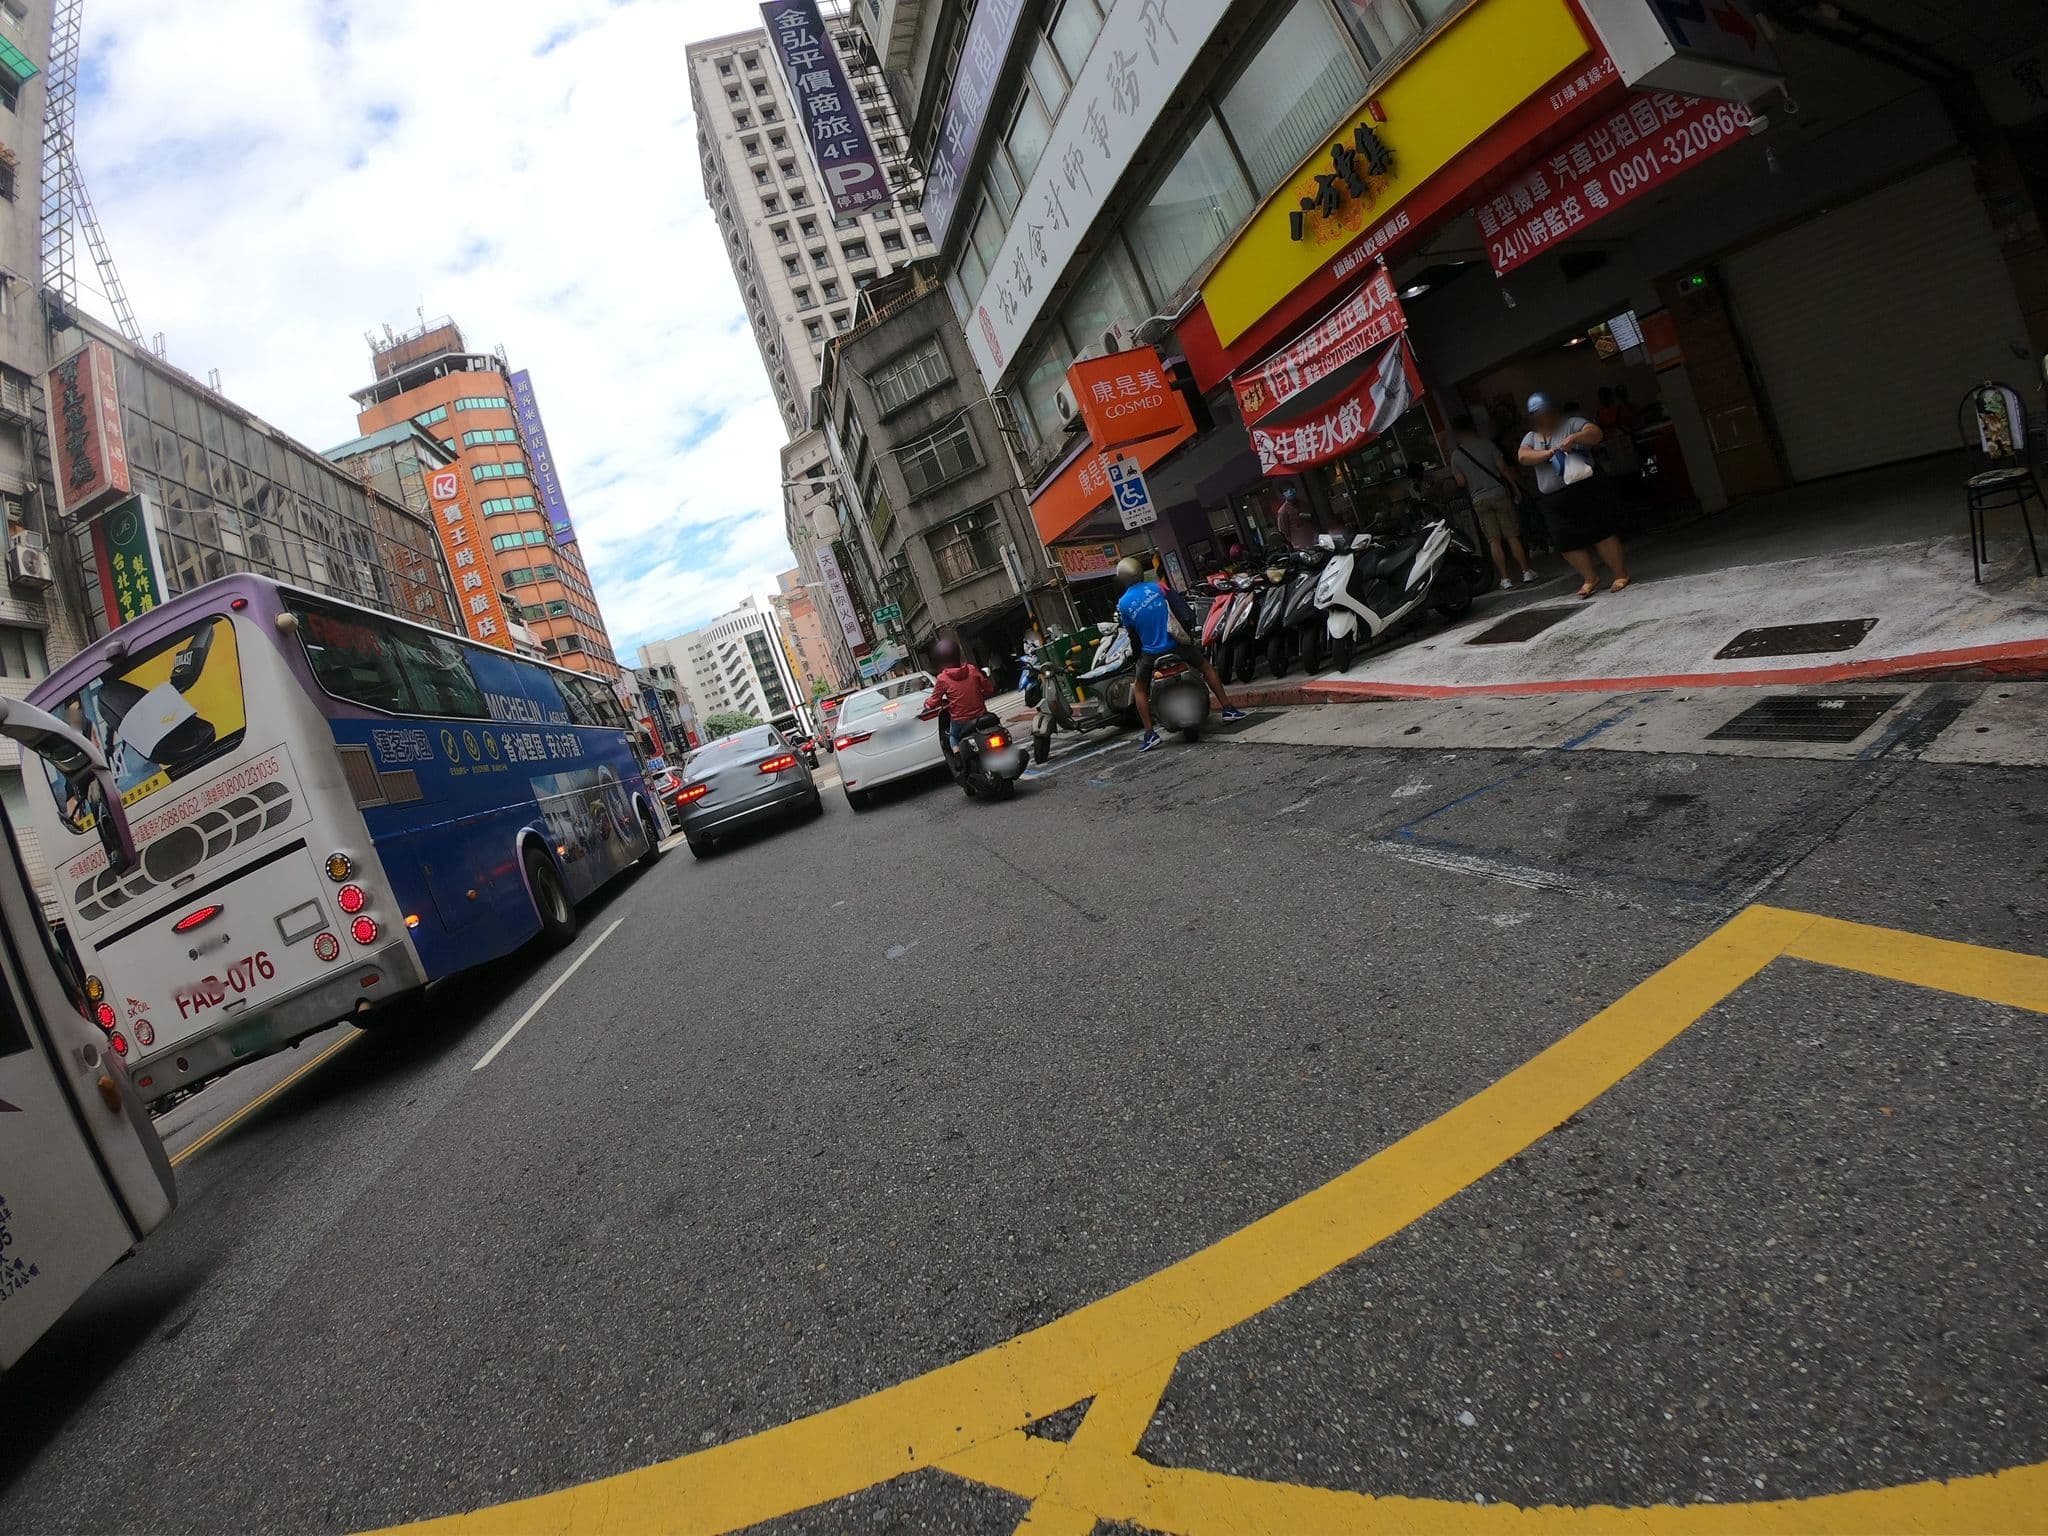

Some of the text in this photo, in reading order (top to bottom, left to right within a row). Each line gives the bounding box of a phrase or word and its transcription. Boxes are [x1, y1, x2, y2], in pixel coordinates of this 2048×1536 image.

[775, 9, 859, 159] 金弘平價商旅 4F
[824, 162, 875, 197] P
[836, 188, 883, 208] 停車場
[1477, 171, 1551, 238] 重型機車
[1492, 196, 1585, 268] 24小時監控
[1583, 179, 1609, 209] 電
[1090, 368, 1162, 404] 康是美
[1105, 394, 1163, 419] COSMED
[517, 382, 544, 449] 新客來旅店
[1275, 398, 1366, 465] 生鮮水餃
[537, 452, 558, 506] HOTEL
[442, 504, 497, 639] 寶王時尚旅店
[485, 693, 542, 722] MICHELIN
[501, 732, 547, 763] 省油堅固
